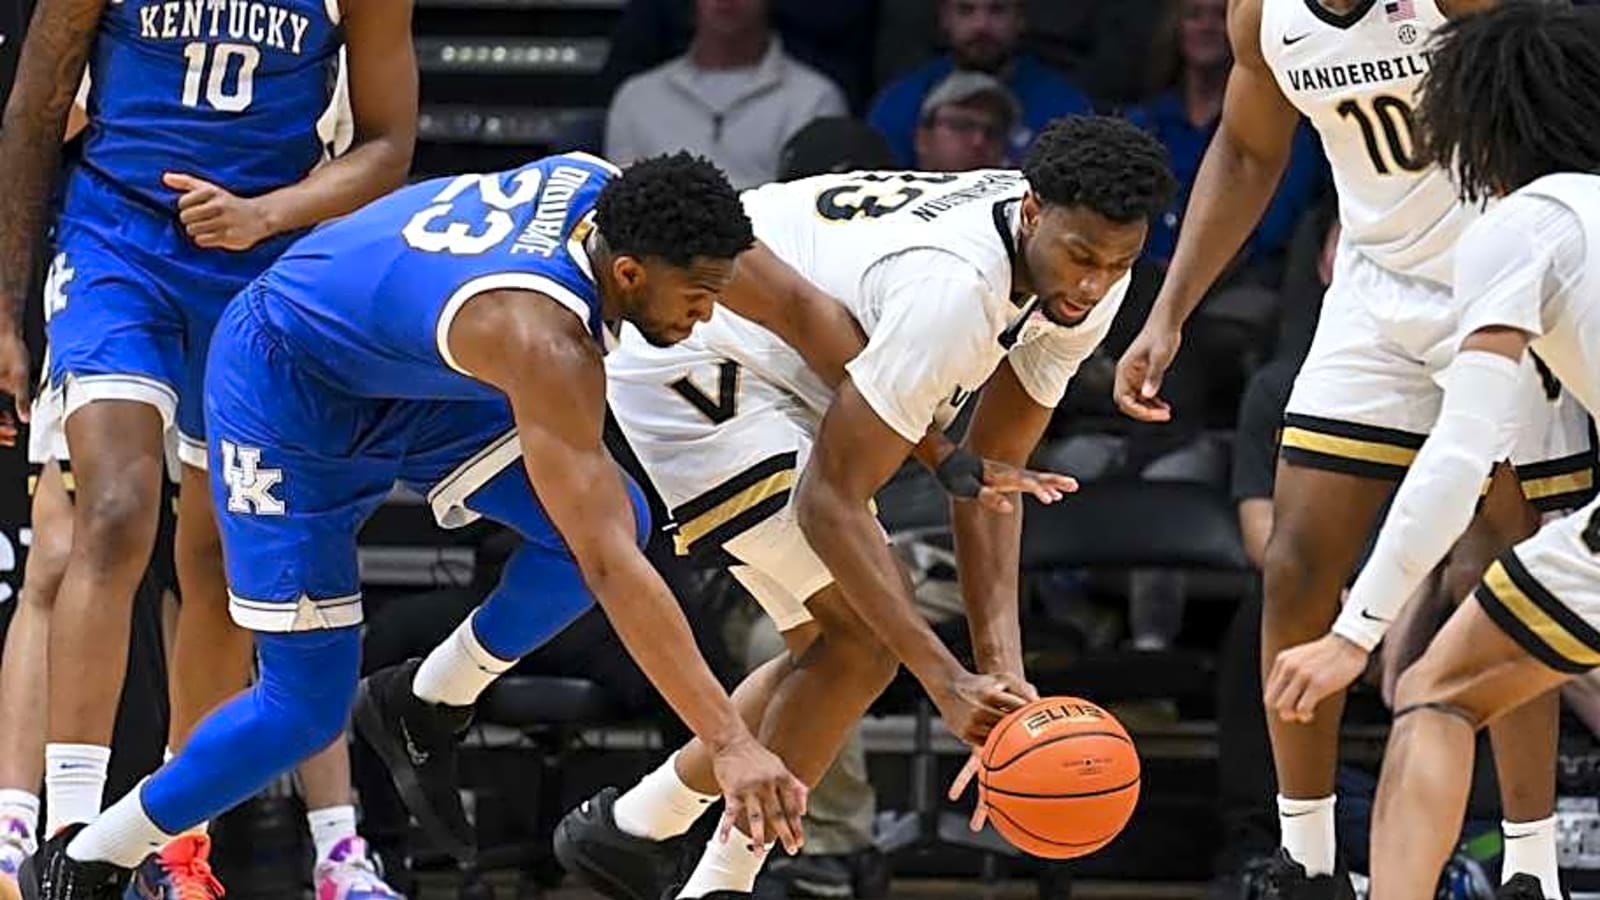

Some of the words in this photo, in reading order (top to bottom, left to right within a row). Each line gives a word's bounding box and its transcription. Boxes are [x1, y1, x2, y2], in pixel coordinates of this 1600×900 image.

[139, 0, 309, 54] KENTUCKY
[182, 42, 261, 112] 10
[1287, 52, 1433, 91] VANDERBILT
[1336, 95, 1433, 175] 10
[401, 167, 543, 255] 23
[665, 358, 740, 426] V
[220, 439, 286, 517] UK
[1026, 703, 1104, 734] ELITE
